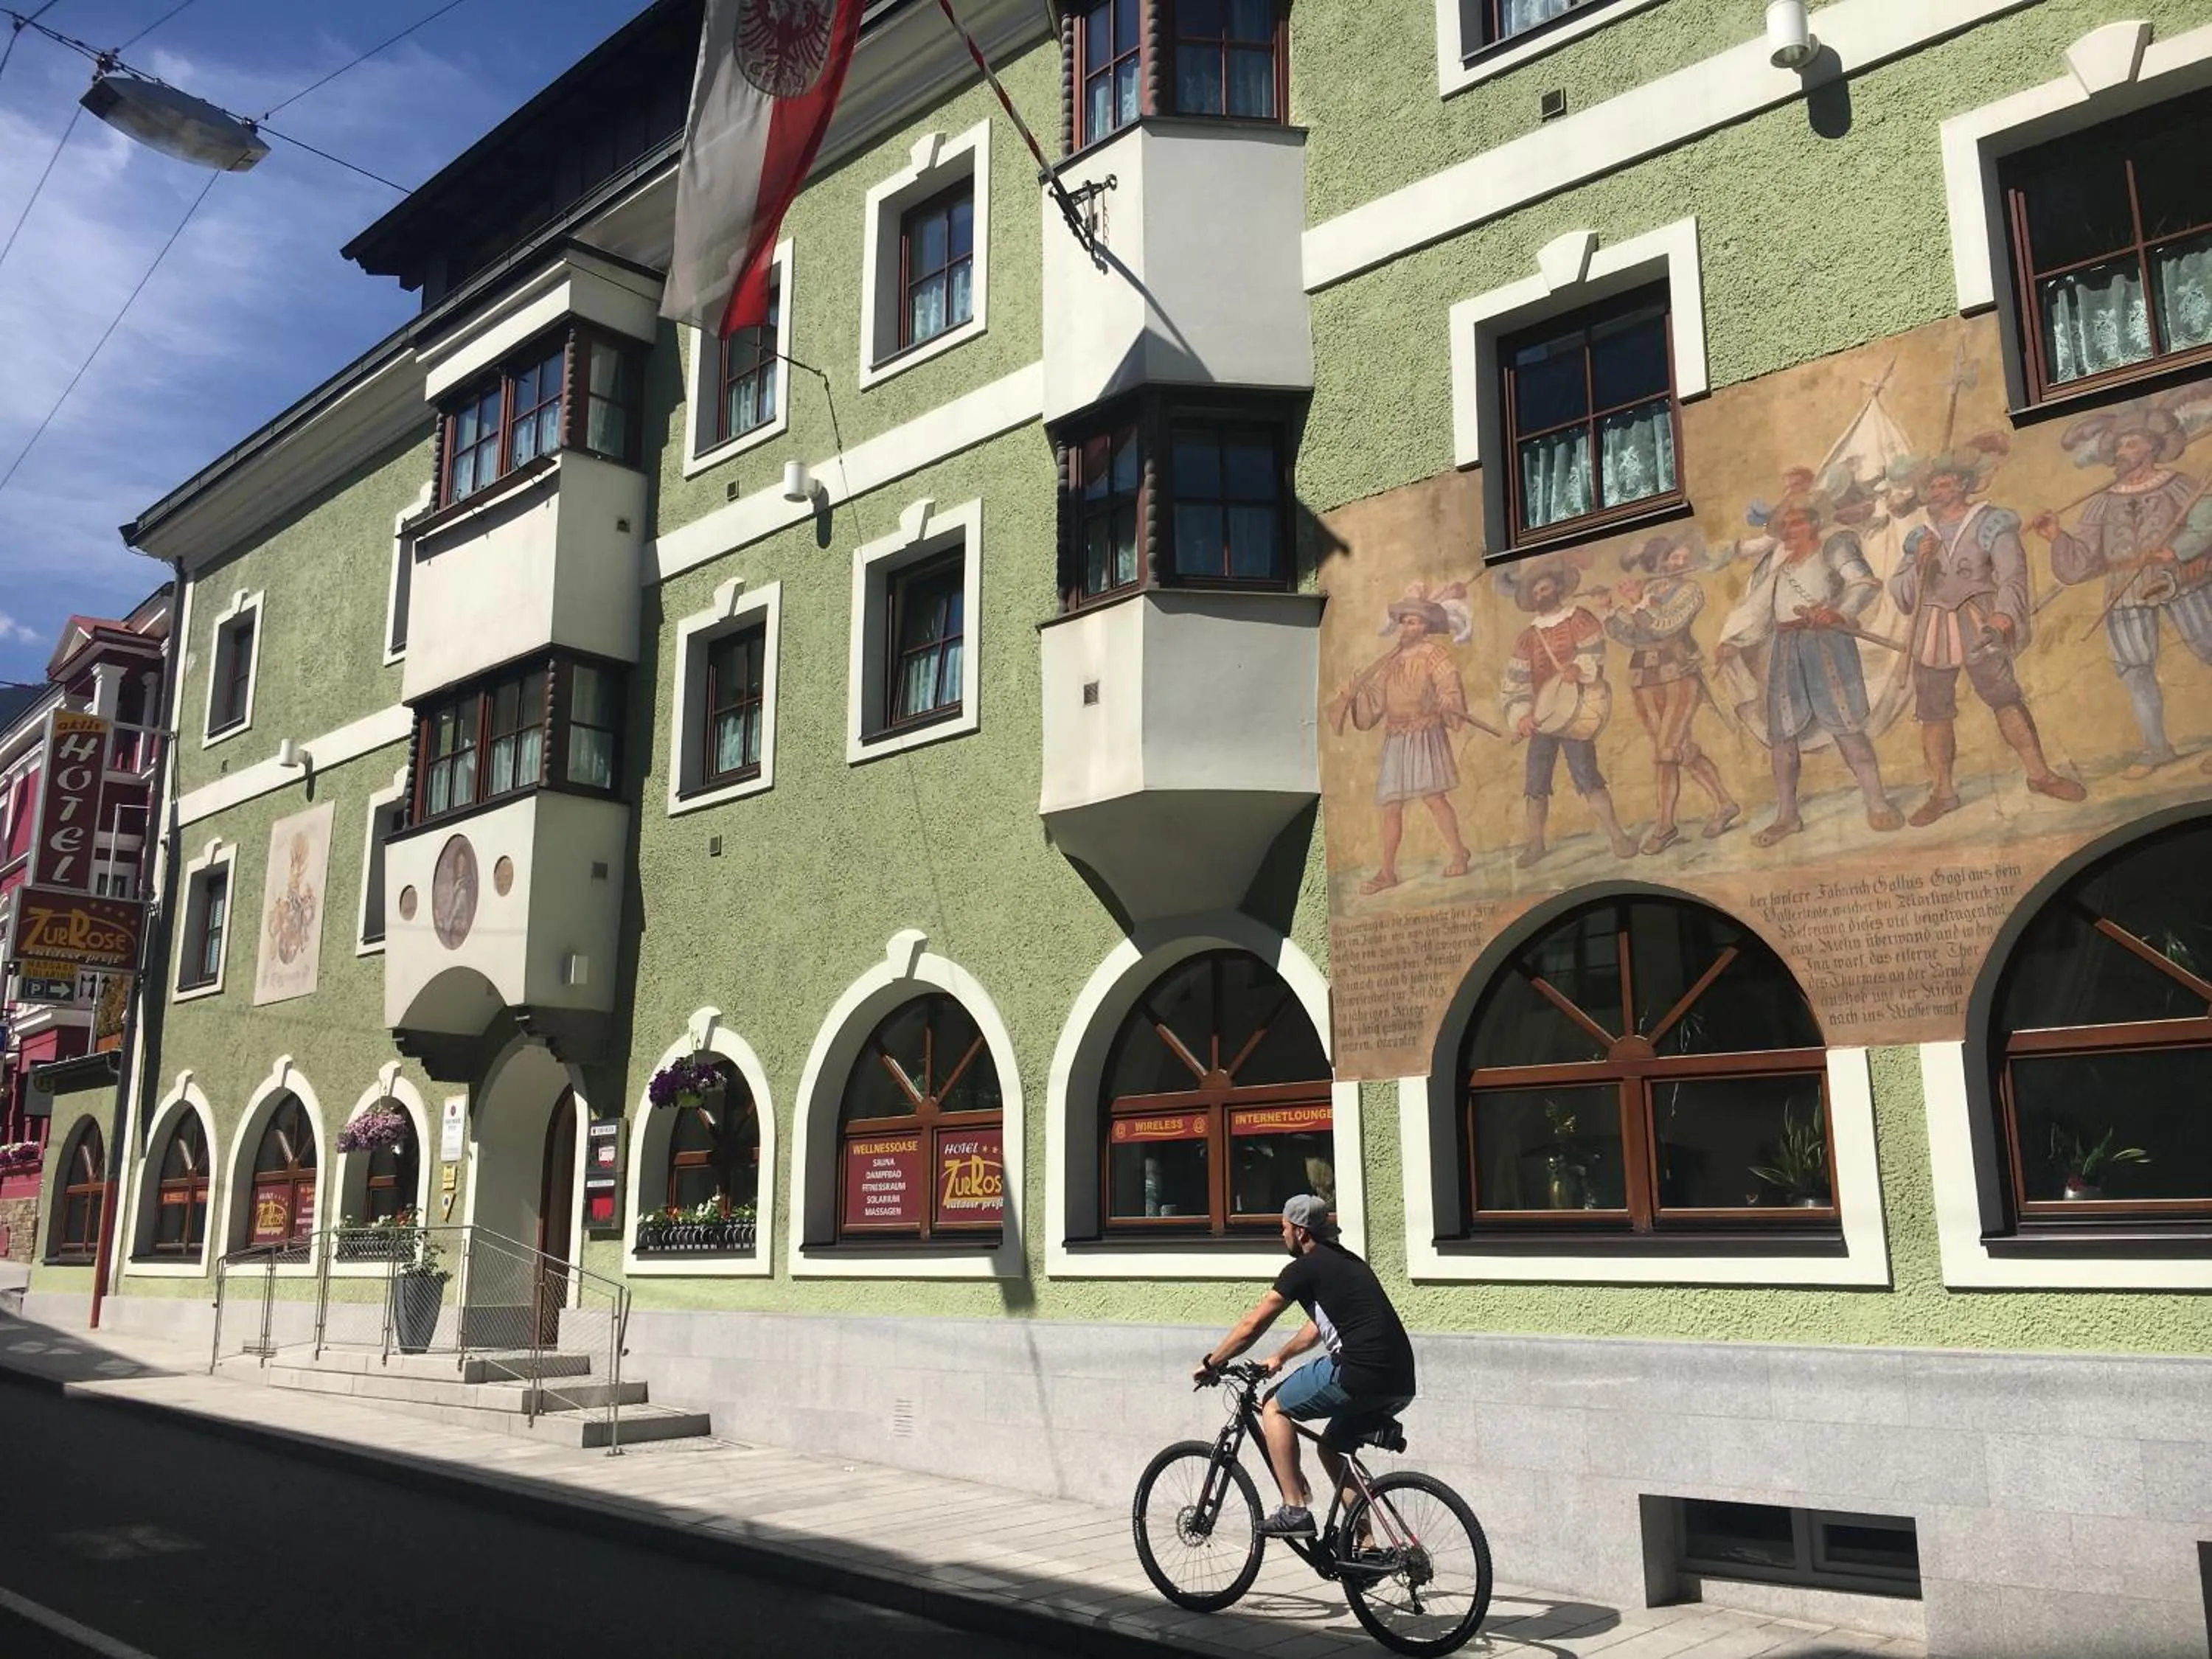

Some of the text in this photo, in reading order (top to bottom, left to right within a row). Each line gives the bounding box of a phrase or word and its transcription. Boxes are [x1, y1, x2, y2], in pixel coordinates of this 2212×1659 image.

[49, 734, 97, 883] HOTEL
[1235, 1108, 1332, 1124] INTERNETLOUNGE
[1135, 1119, 1183, 1132] WIRELESS
[852, 1141, 918, 1155] WELLNESSOASE
[945, 1142, 978, 1155] HOTEL
[872, 1158, 896, 1167] SAUNA
[867, 1194, 900, 1204] SOLARIUM
[865, 1208, 902, 1217] MASSAGEN
